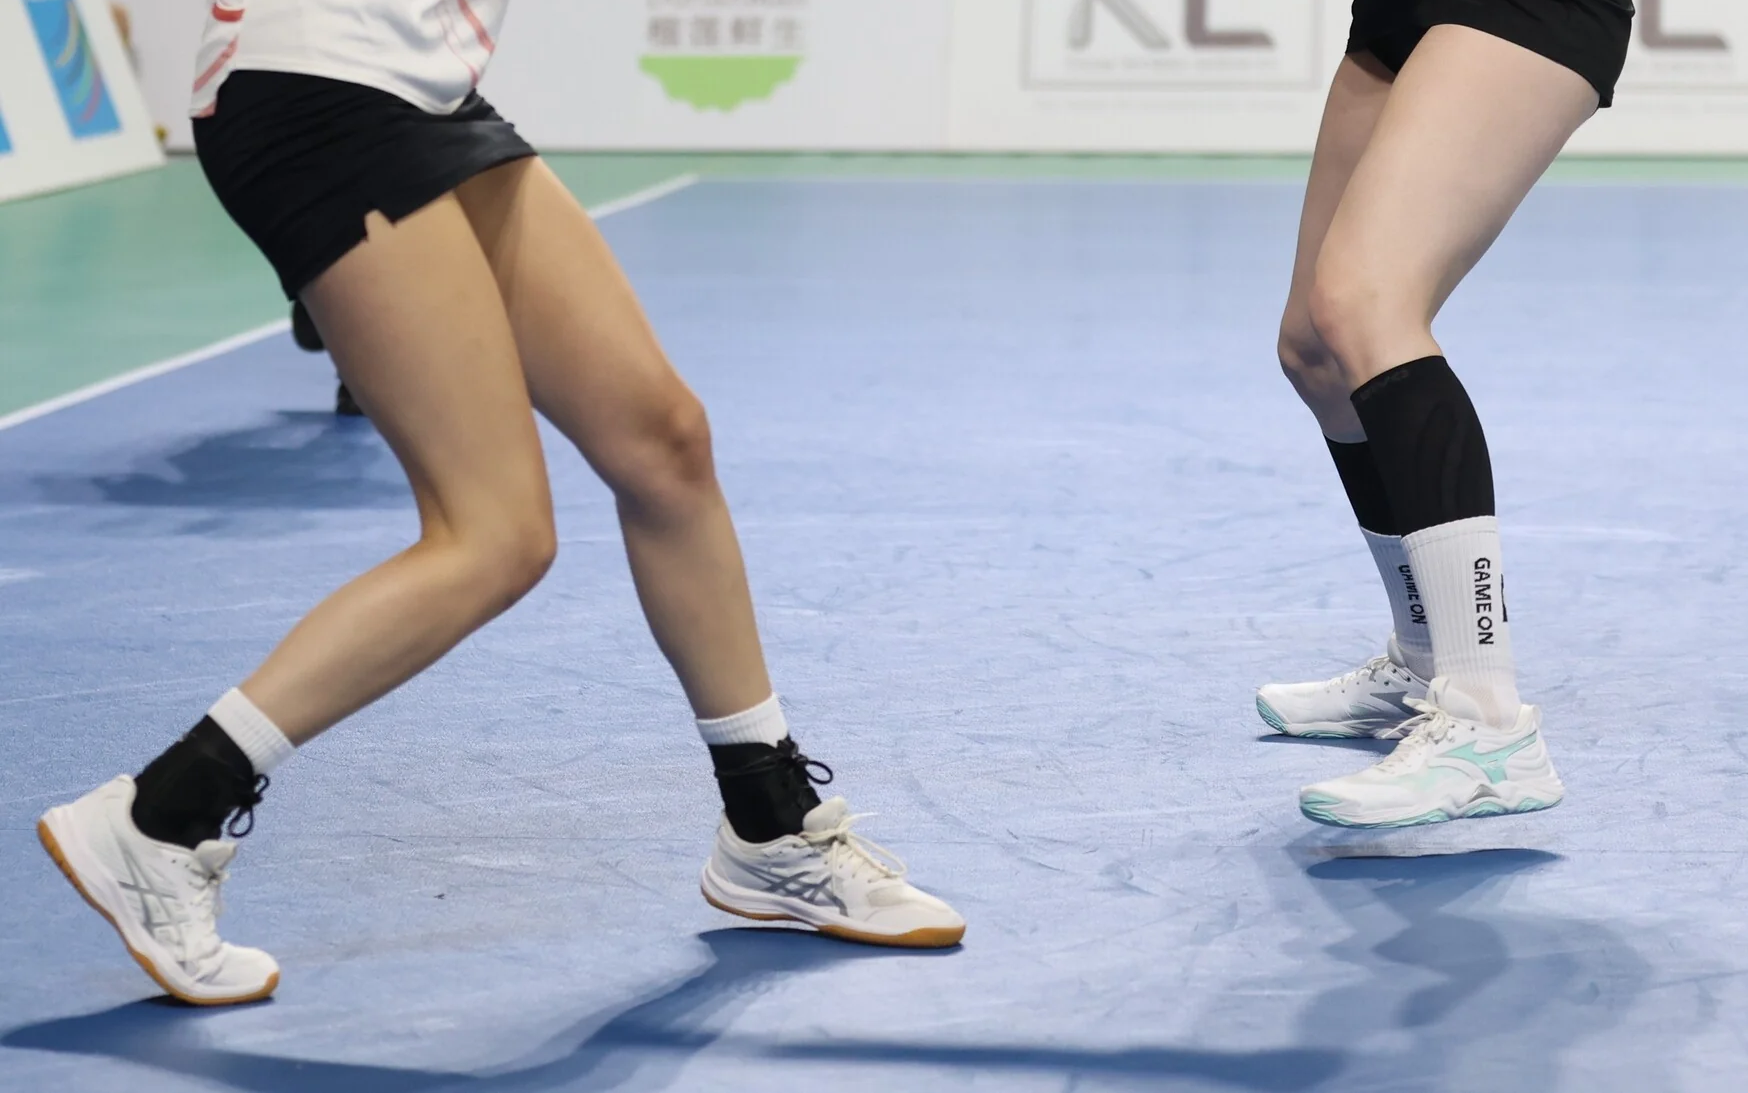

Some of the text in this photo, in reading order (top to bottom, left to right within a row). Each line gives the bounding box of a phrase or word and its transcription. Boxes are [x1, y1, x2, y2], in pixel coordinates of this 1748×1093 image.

[1410, 603, 1428, 625] ON
[1474, 557, 1494, 645] GAME ON
